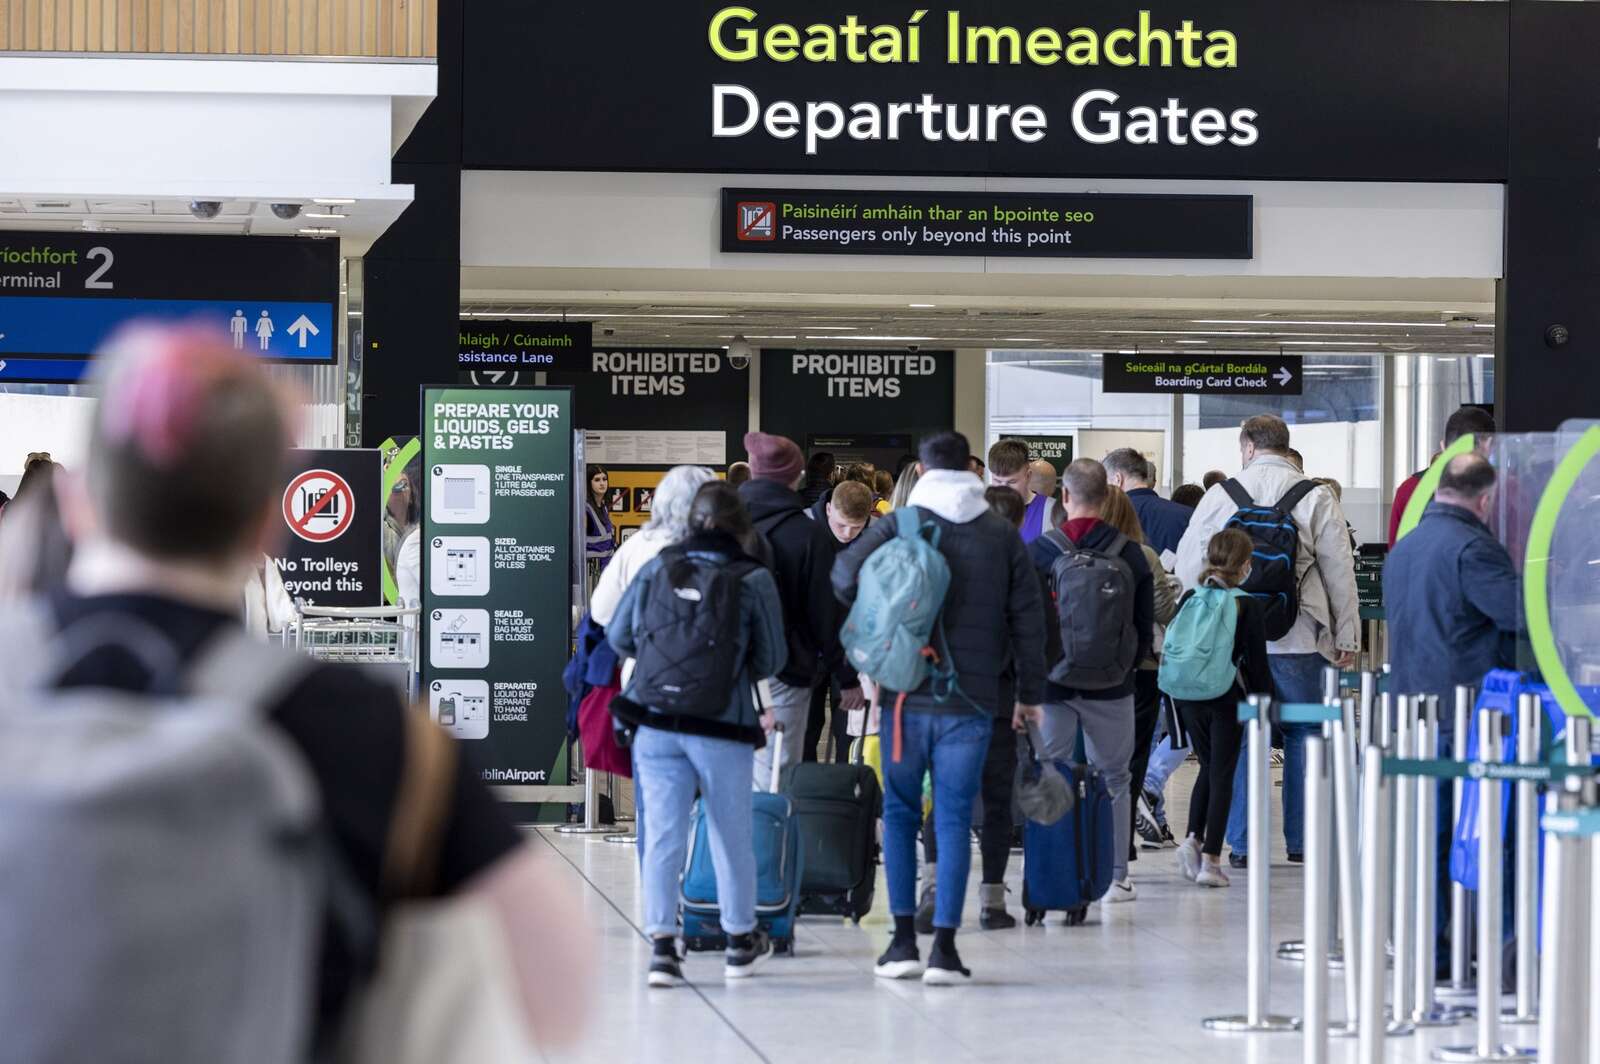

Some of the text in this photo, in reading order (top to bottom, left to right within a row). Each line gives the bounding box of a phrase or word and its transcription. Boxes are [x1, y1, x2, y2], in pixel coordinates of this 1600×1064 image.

[708, 6, 1238, 68] Geataí Imeachta
[711, 83, 1260, 155] Departure Gates
[782, 203, 1094, 225] Paisinéirí amháin thar an bpointe seo
[782, 225, 1072, 247] Passengers only beyond this point
[84, 246, 114, 290] 2
[503, 333, 510, 347] /
[513, 334, 573, 347] Cúnaimh
[458, 350, 554, 363] ssistance Lane
[592, 352, 721, 373] ROHIBITED
[792, 354, 937, 375] PROHIBITED
[1126, 362, 1268, 375] Seiceáil na gCártaí Bordála
[611, 374, 686, 396] ITEMS
[1155, 376, 1268, 388] Boarding Card Check
[827, 377, 901, 398] ITEMS
[433, 403, 560, 419] PREPARE YOUR
[433, 419, 550, 437] LIQUIDS, GELS
[433, 435, 514, 450] & PASTES
[1044, 442, 1067, 450] YOUR
[1041, 450, 1062, 458] GELS
[495, 465, 523, 473] SINGLE
[495, 473, 565, 481] ONE TRANSPARENT
[500, 481, 521, 489] LITRE
[521, 481, 537, 489] BAG
[495, 489, 555, 497] PER PASSENGER
[494, 538, 517, 546] SIZED
[494, 546, 556, 554] ALL CONTAINERS
[494, 554, 552, 562] MUST BE 100ML
[275, 557, 359, 575] No Trolleys
[494, 561, 526, 569] OR LESS
[335, 578, 363, 592] this
[494, 610, 524, 618] SEALED
[494, 618, 534, 626] THE LIQUID
[494, 625, 532, 633] BAG MUST
[494, 633, 535, 641] BE CLOSED
[493, 682, 538, 690] SEPARATED
[493, 690, 535, 698] LIQUID BAG
[493, 698, 532, 706] SEPARATE
[494, 705, 527, 714] TO HAND
[493, 713, 529, 722] LUGGAGE
